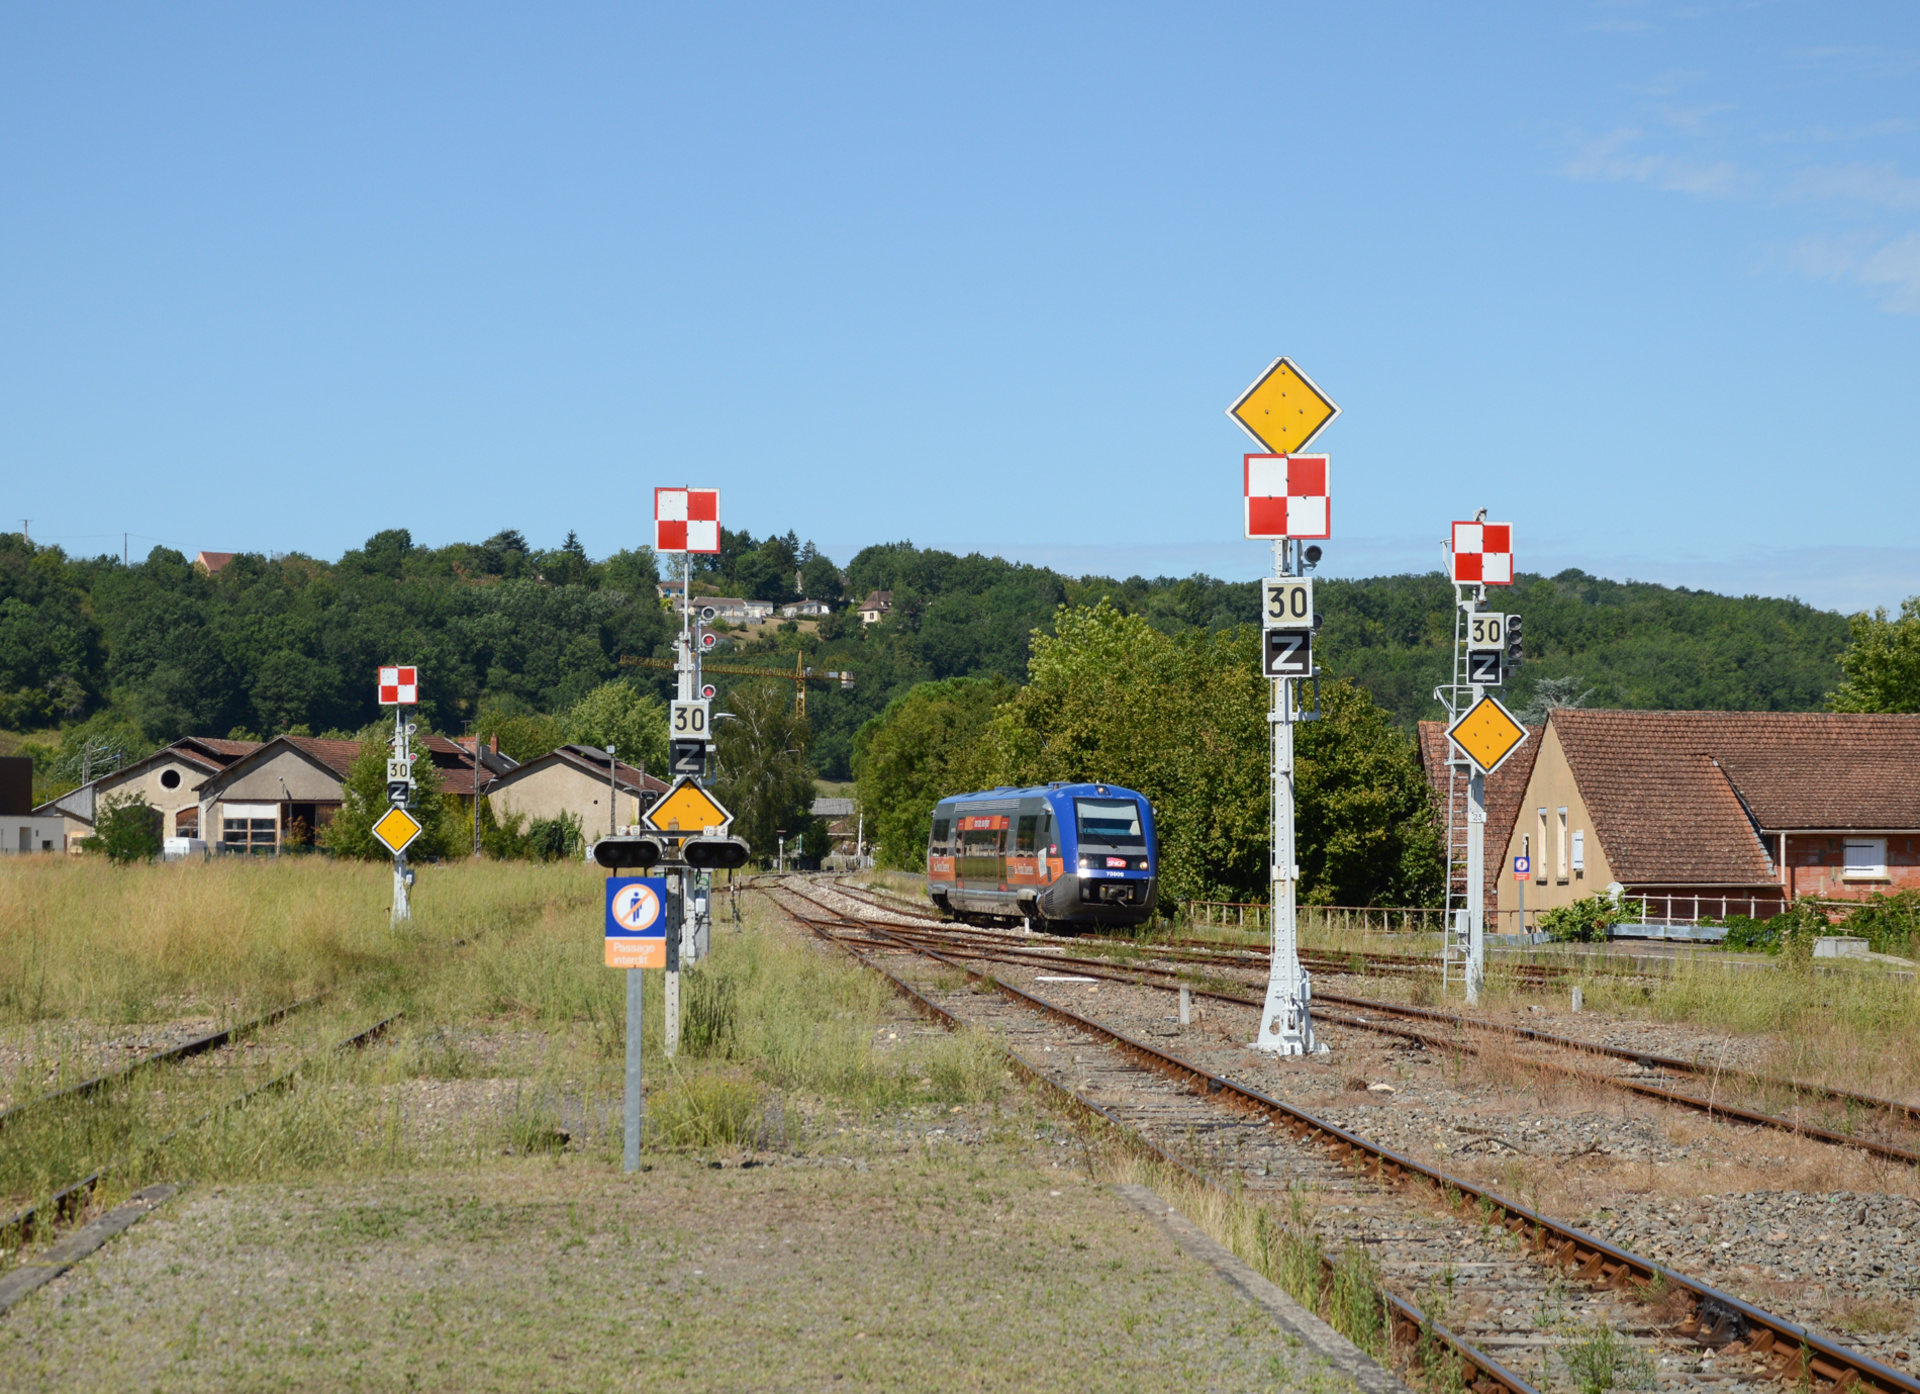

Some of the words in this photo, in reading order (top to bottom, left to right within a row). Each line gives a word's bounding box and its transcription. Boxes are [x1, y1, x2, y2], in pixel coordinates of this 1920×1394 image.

[1268, 586, 1307, 618] 30
[1472, 619, 1500, 643] 30
[1271, 635, 1303, 671] Z
[1472, 654, 1496, 680] Z
[674, 706, 704, 732] 30
[675, 743, 700, 770] Z
[390, 763, 408, 777] 30
[390, 783, 406, 800] Z
[613, 942, 656, 955] Passage
[613, 954, 649, 965] interdit
